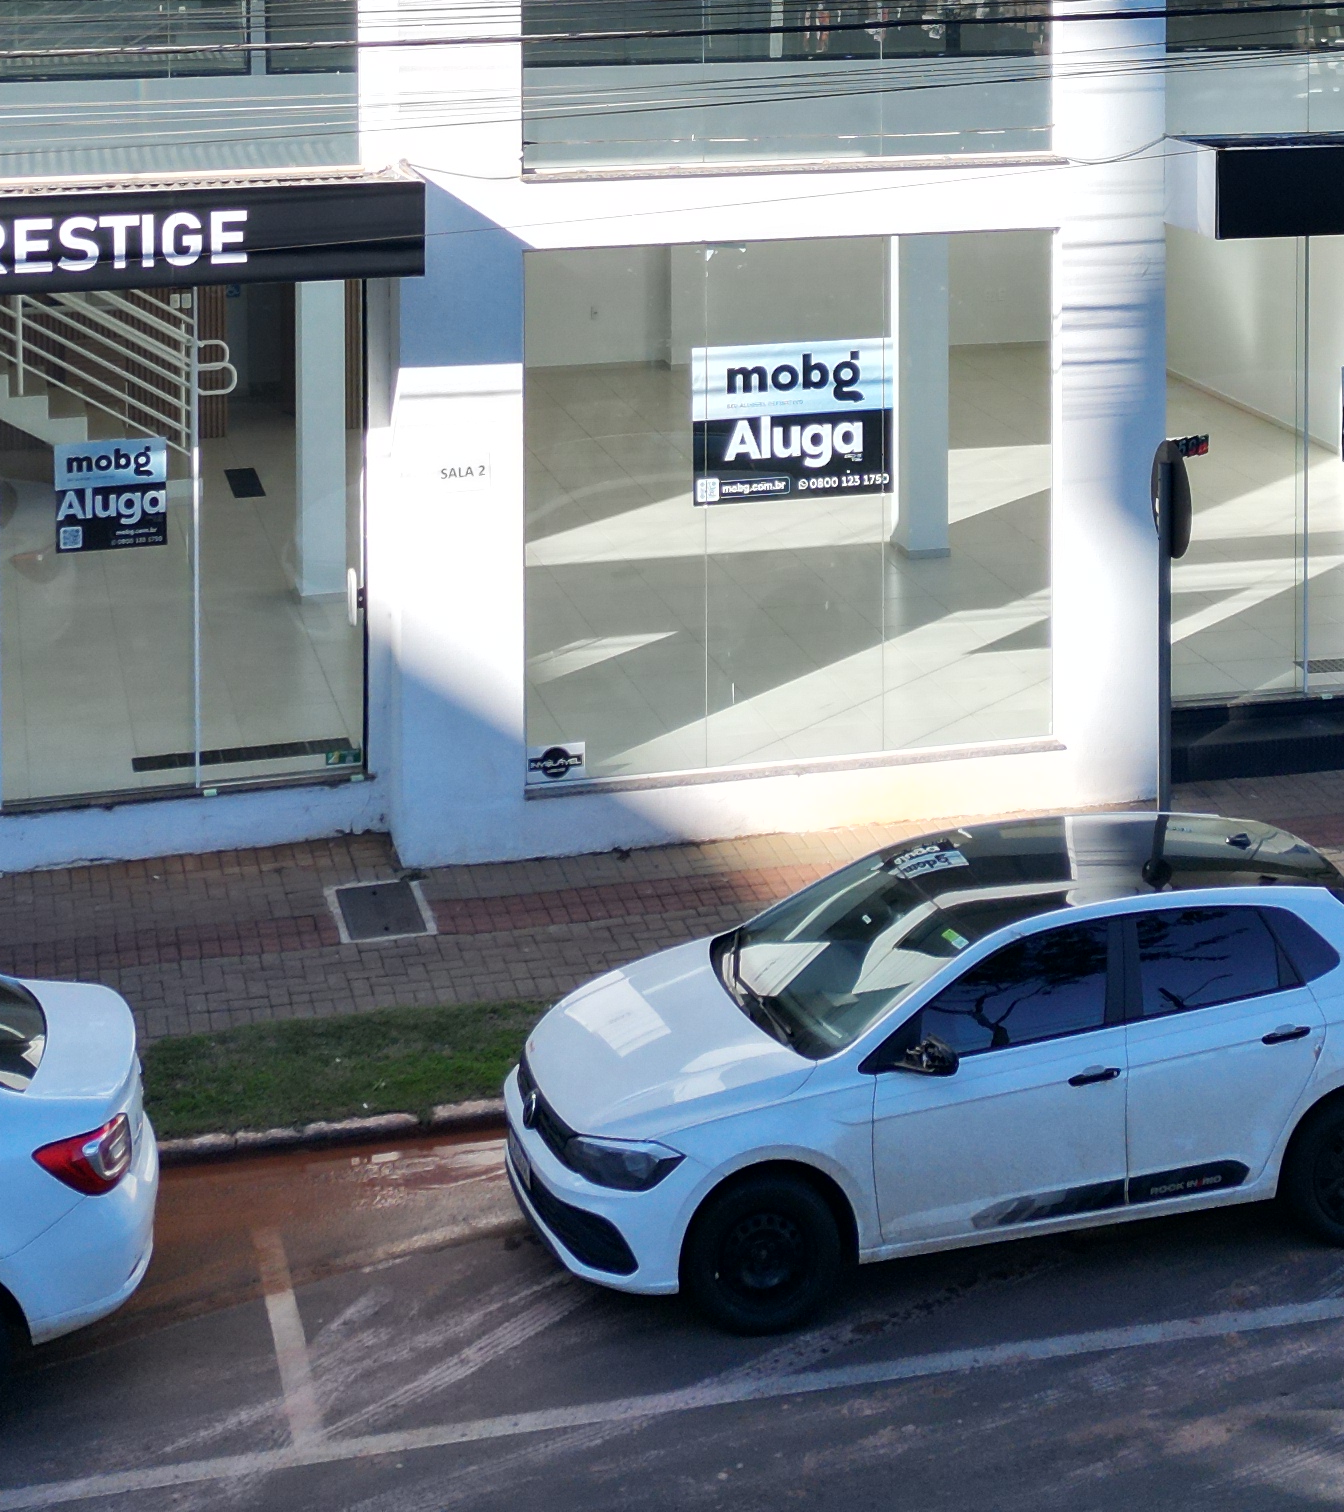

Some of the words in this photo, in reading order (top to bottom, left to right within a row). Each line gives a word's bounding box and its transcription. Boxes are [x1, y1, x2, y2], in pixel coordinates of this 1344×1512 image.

[726, 349, 866, 403] mobg
[723, 415, 864, 469] Aluga
[66, 445, 154, 477] mobg
[440, 466, 474, 479] SALA
[478, 464, 486, 477] 2
[722, 479, 786, 495] mobg.com.br
[809, 476, 839, 489] 0800
[56, 488, 166, 525] Aluga
[1150, 1181, 1185, 1195] ROCK
